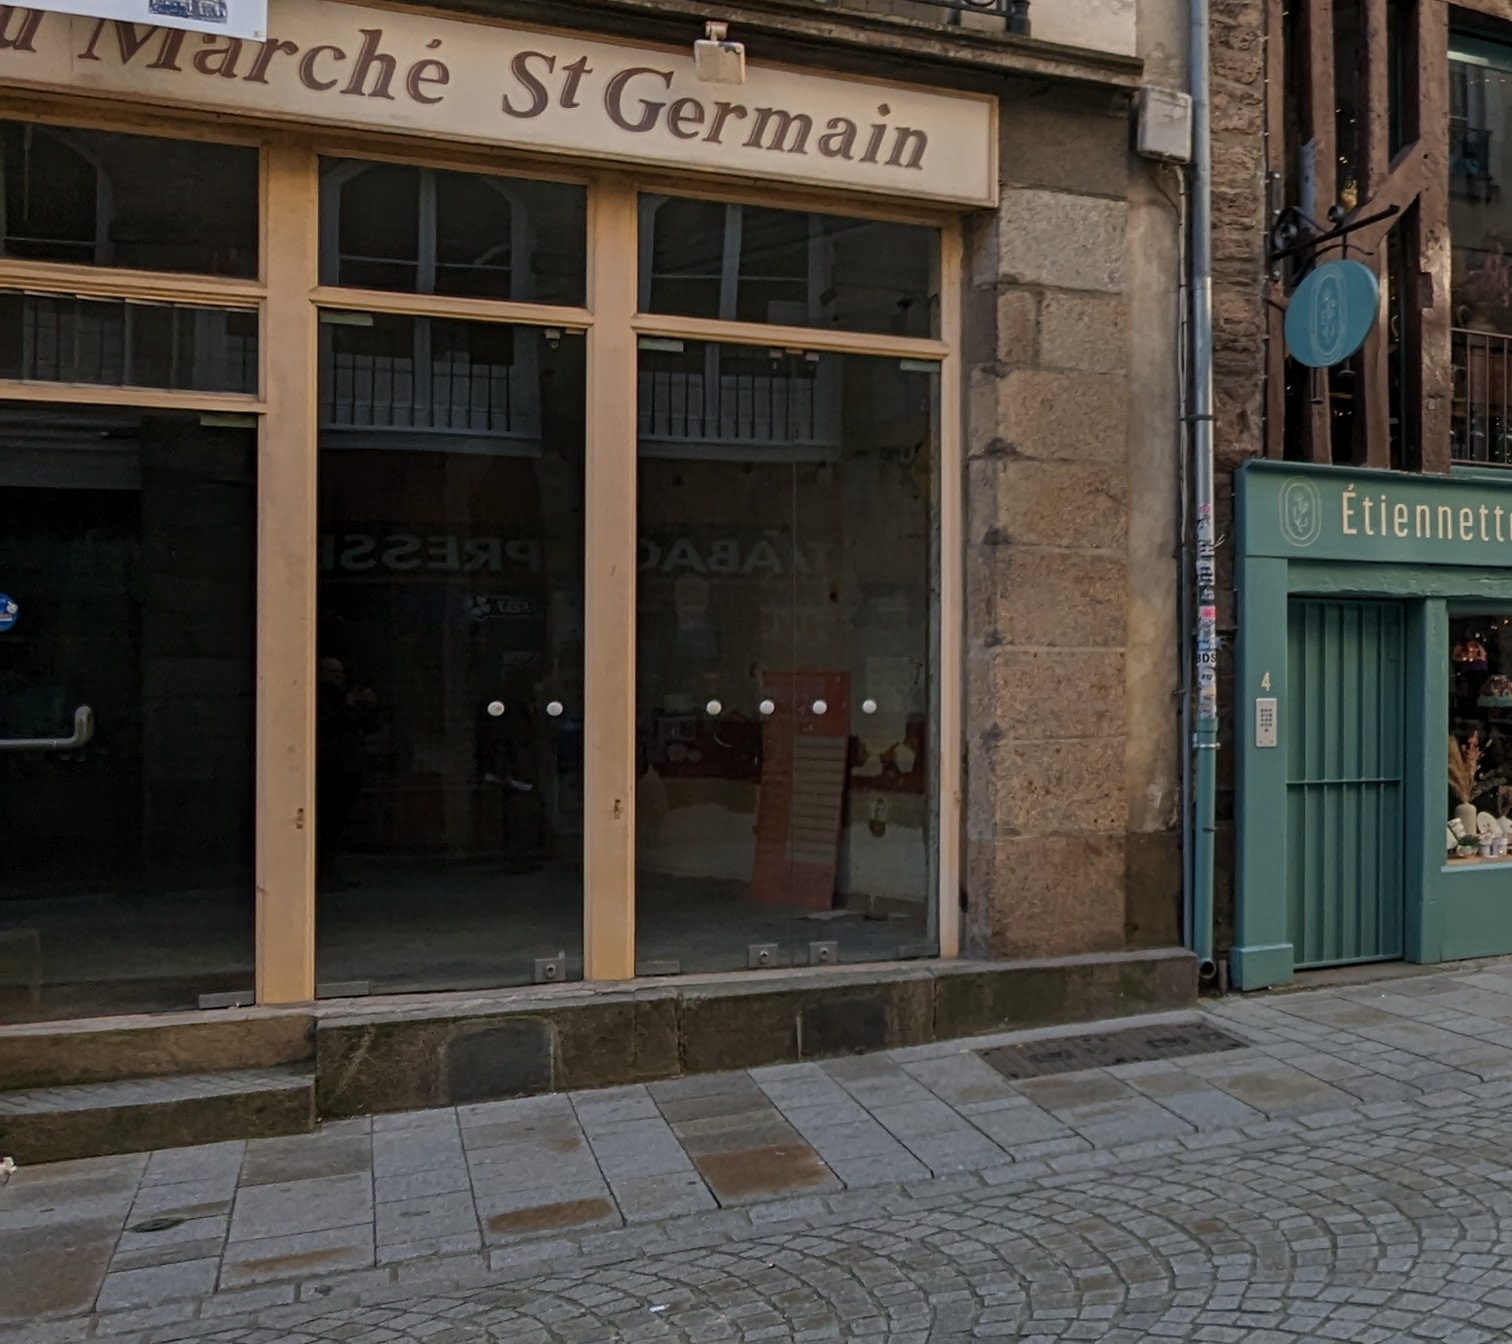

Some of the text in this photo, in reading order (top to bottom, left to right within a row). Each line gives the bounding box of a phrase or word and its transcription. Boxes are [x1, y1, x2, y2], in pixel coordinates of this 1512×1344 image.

[78, 17, 450, 105] Marché
[502, 50, 593, 119] St
[604, 67, 929, 171] Germain
[1261, 672, 1271, 692] 4
